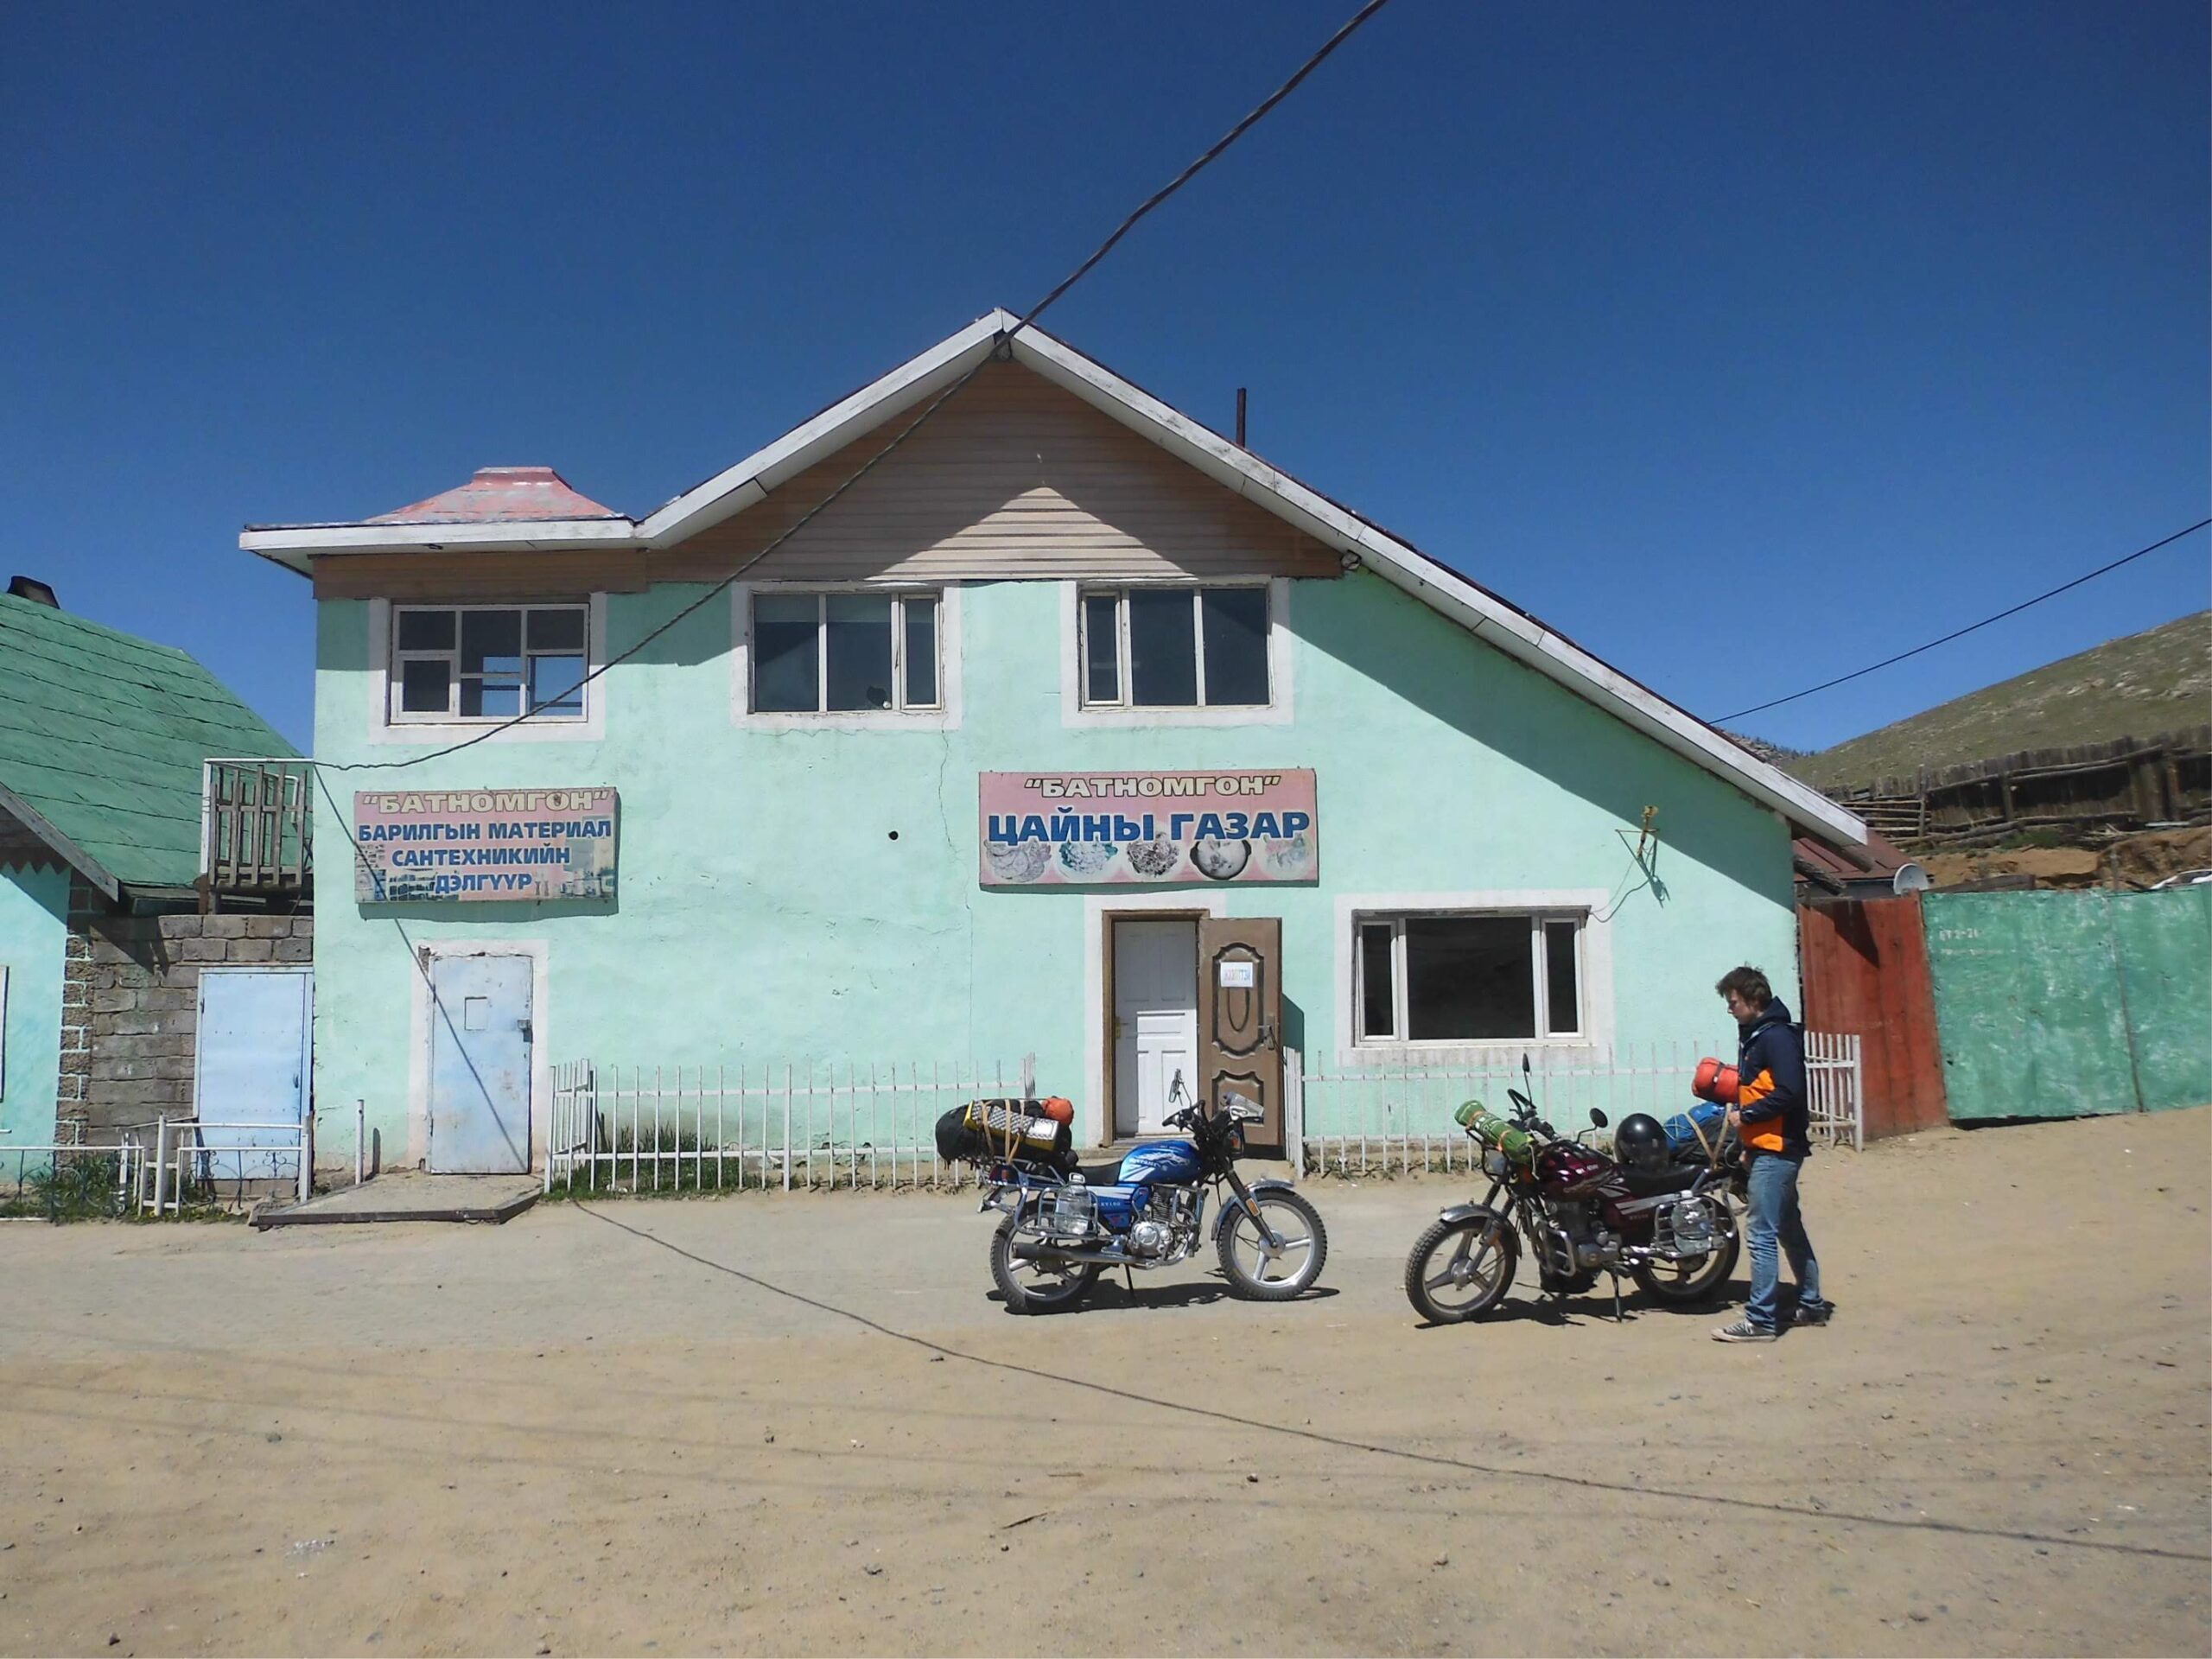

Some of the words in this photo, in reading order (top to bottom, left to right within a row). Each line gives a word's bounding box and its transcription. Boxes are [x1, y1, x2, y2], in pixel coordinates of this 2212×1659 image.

[359, 823, 480, 842] БАРИЛГЫН
[488, 820, 612, 839] МАТЕРИАЛ
[988, 807, 1154, 846] ЦАЙНЫ
[1170, 812, 1310, 840] ГАЗАР
[391, 842, 570, 867] САНТЕХНИКИЙН
[435, 873, 532, 894] ДЭЛГҮҮР
